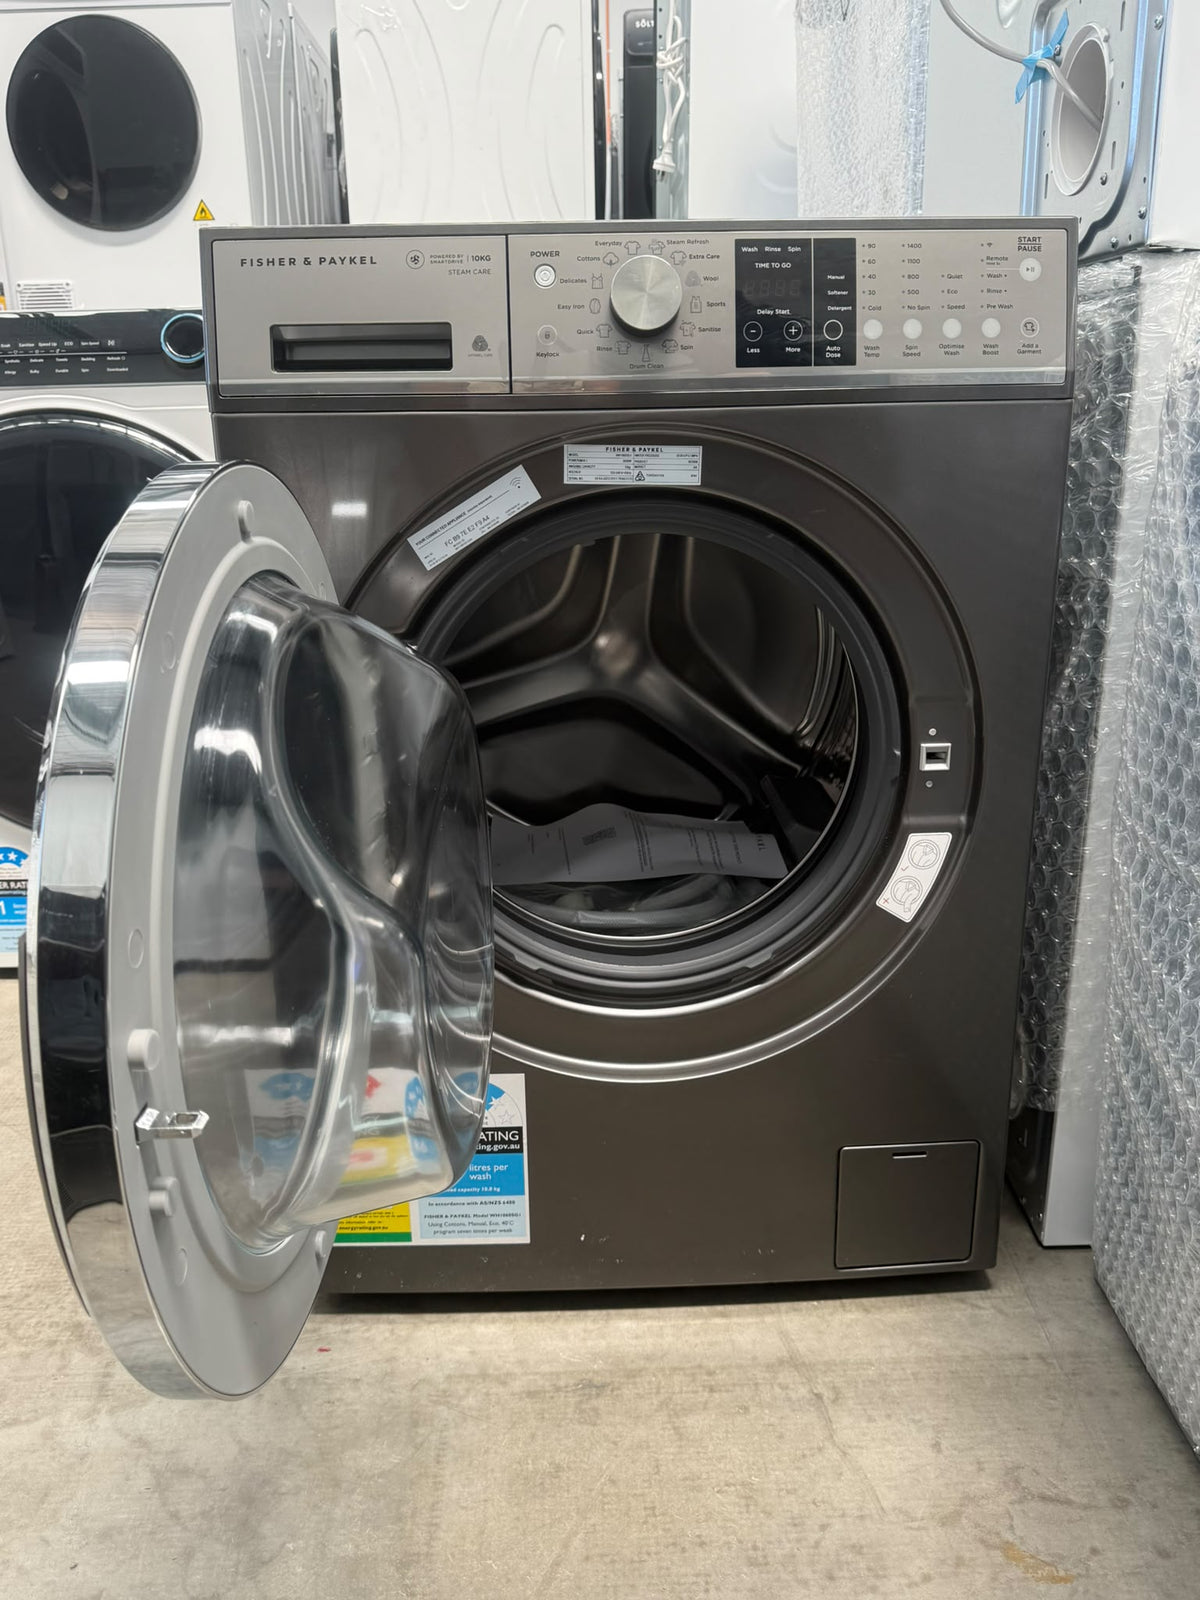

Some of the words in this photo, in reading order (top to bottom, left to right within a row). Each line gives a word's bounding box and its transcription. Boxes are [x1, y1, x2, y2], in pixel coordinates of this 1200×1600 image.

[240, 257, 297, 268] FISHER
[303, 256, 313, 266] &
[319, 255, 378, 266] PAYKEL
[471, 254, 492, 262] 10KG
[479, 1130, 519, 1142] ATING
[476, 1144, 520, 1152] ting.gov.au
